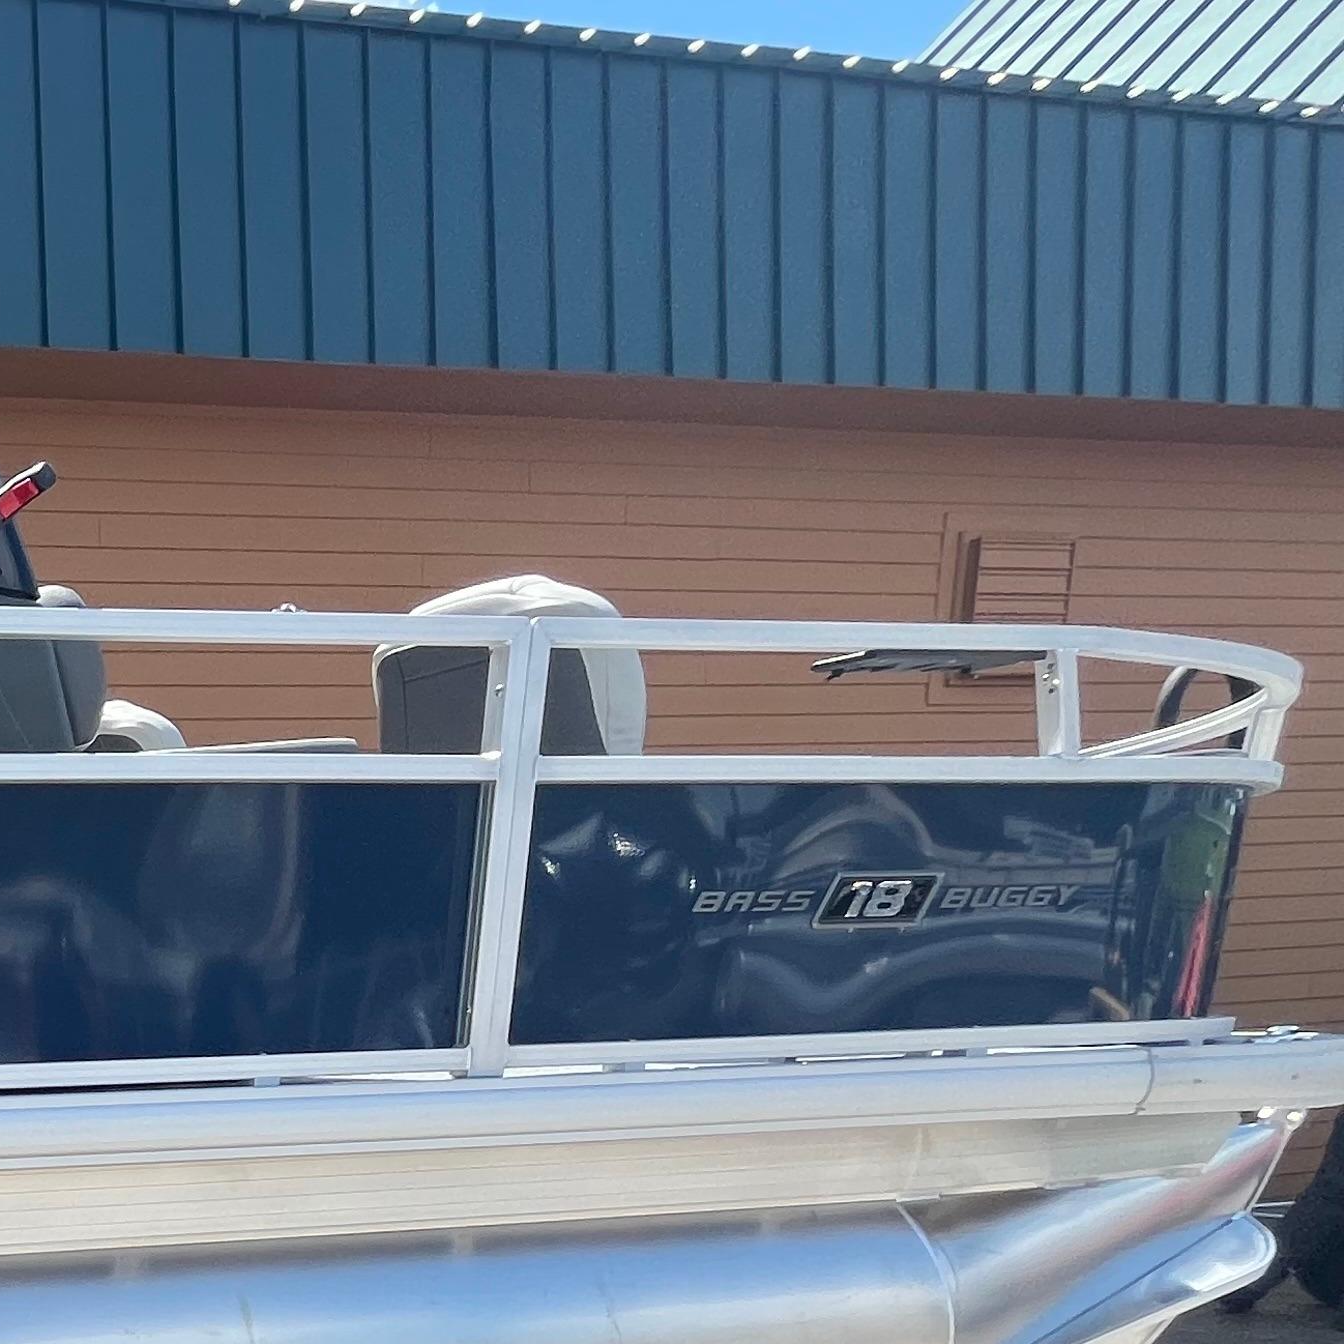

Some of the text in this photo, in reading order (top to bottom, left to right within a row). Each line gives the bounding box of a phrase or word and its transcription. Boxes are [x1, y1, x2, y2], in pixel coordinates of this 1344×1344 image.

[692, 879, 1079, 918] BASS 18 BUGGY
